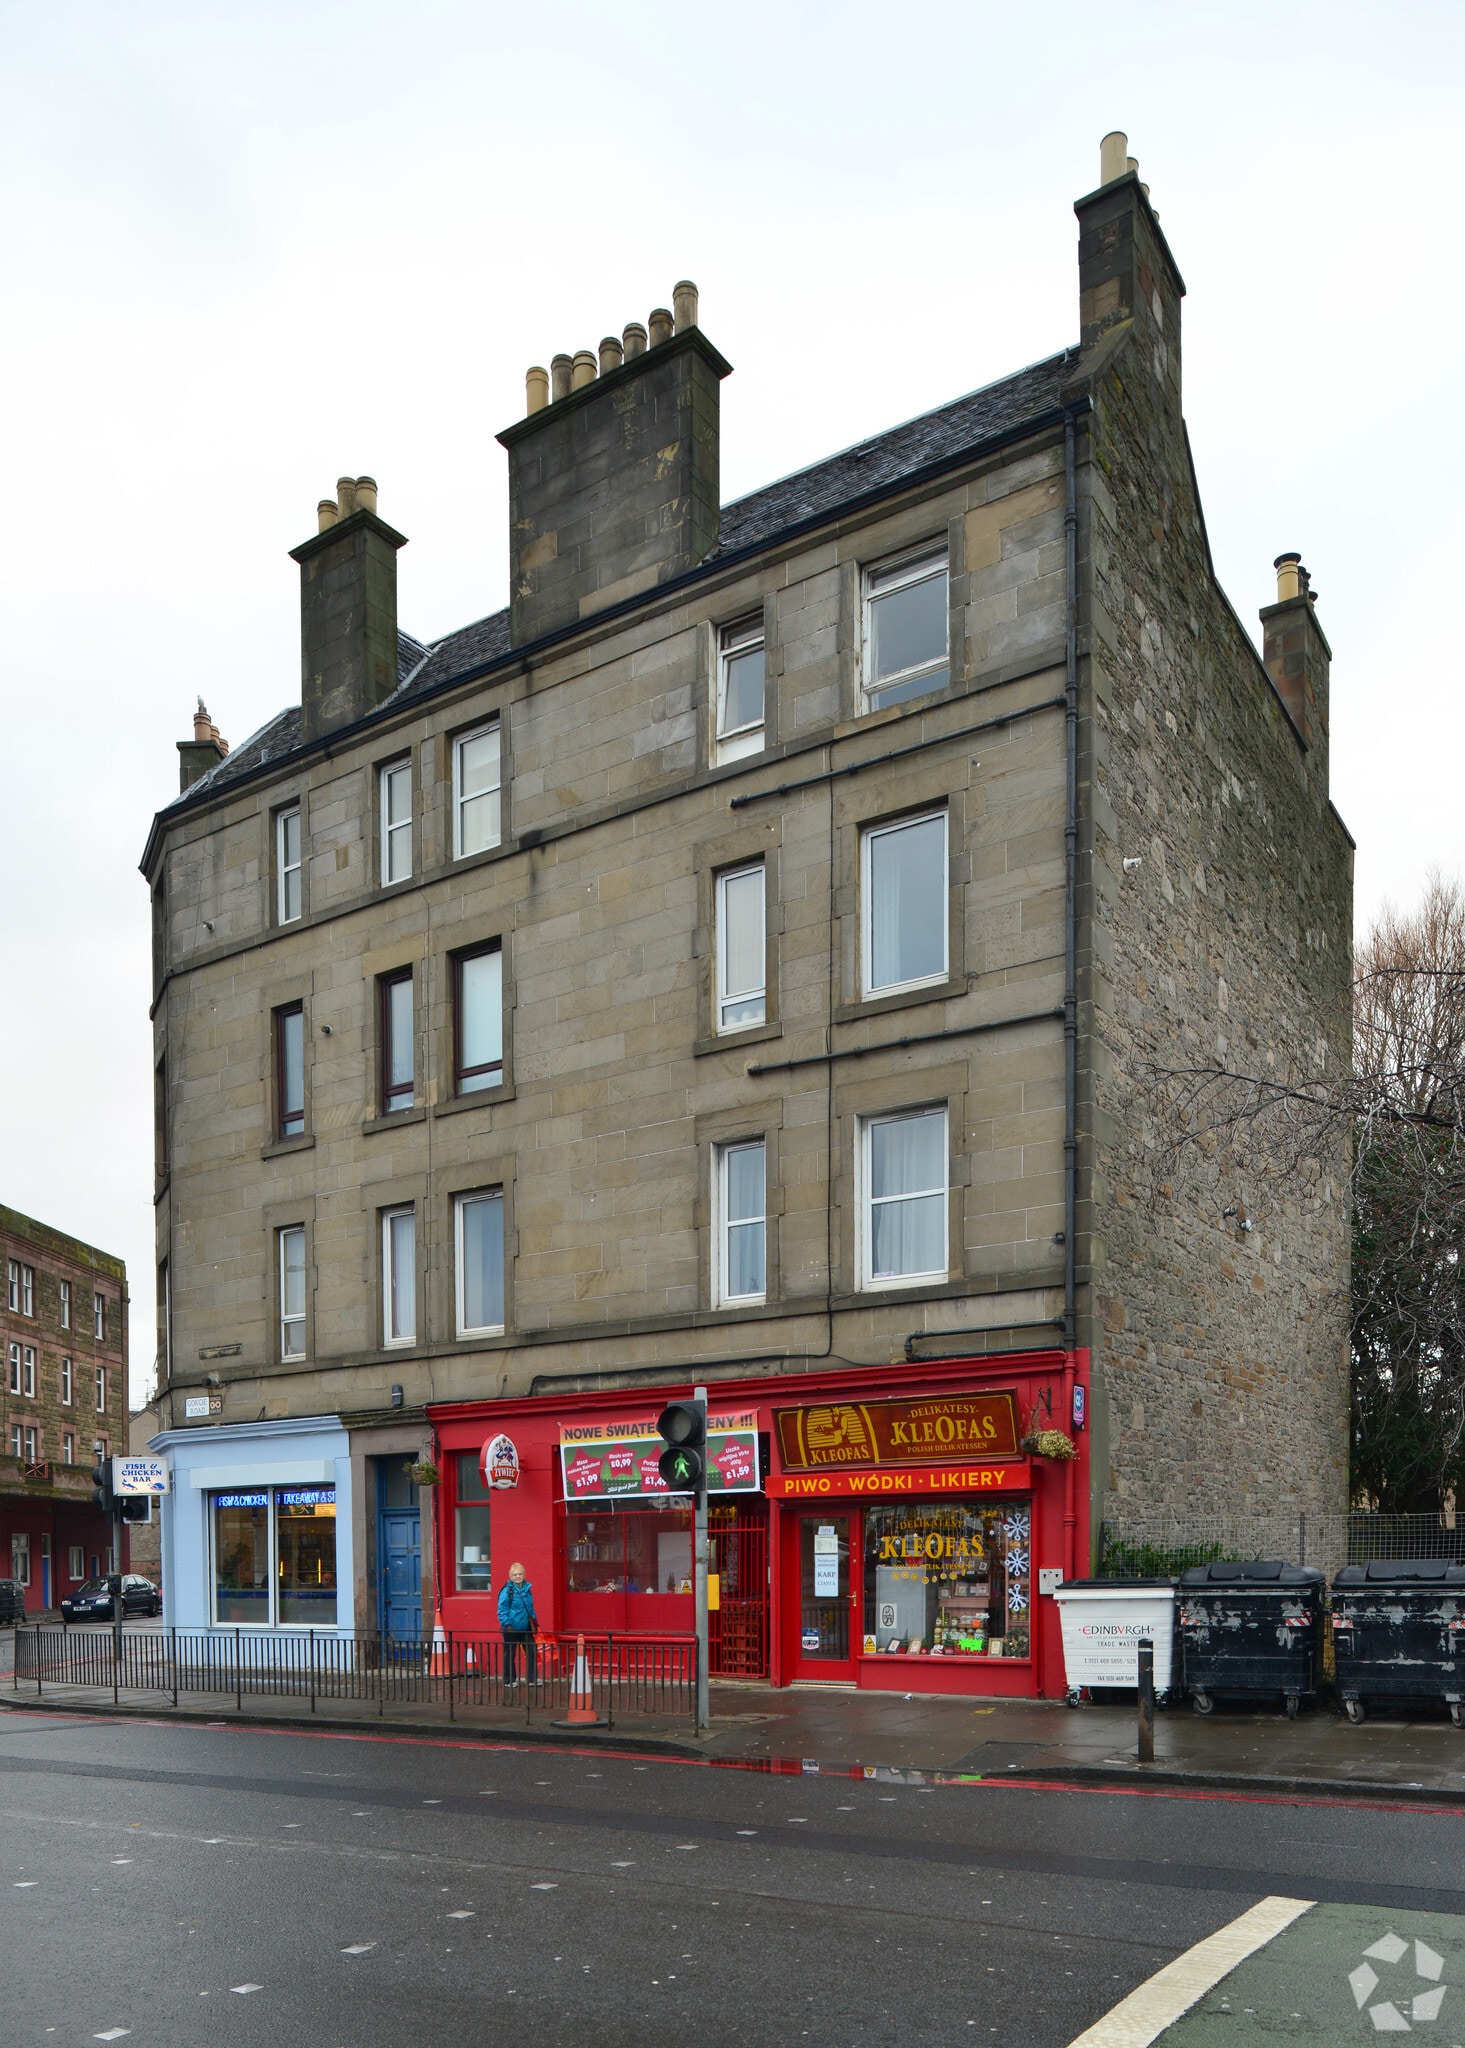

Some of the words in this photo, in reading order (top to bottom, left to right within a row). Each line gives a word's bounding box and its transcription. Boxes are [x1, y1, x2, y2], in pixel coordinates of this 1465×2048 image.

[187, 1399, 207, 1407] GORGIE
[210, 1401, 221, 1409] GO
[190, 1407, 206, 1415] ROAD
[565, 1427, 602, 1440] NOWE
[706, 1415, 736, 1429] ENY
[740, 1414, 753, 1427] !!!
[934, 1442, 988, 1451] DELIKATESSEN
[810, 1445, 870, 1465] KLEOFAS
[611, 1458, 631, 1468] £0,99
[726, 1465, 750, 1479] £1,59
[576, 1473, 598, 1487] £1,99
[785, 1478, 831, 1493] PIWO
[849, 1474, 912, 1491] WÓDKI
[930, 1470, 1006, 1488] LIKIERY
[284, 1491, 320, 1504] TAKEAWAY
[320, 1491, 327, 1503] &
[899, 1519, 964, 1530] DELIKATESY
[879, 1532, 985, 1559] KLEOFAS
